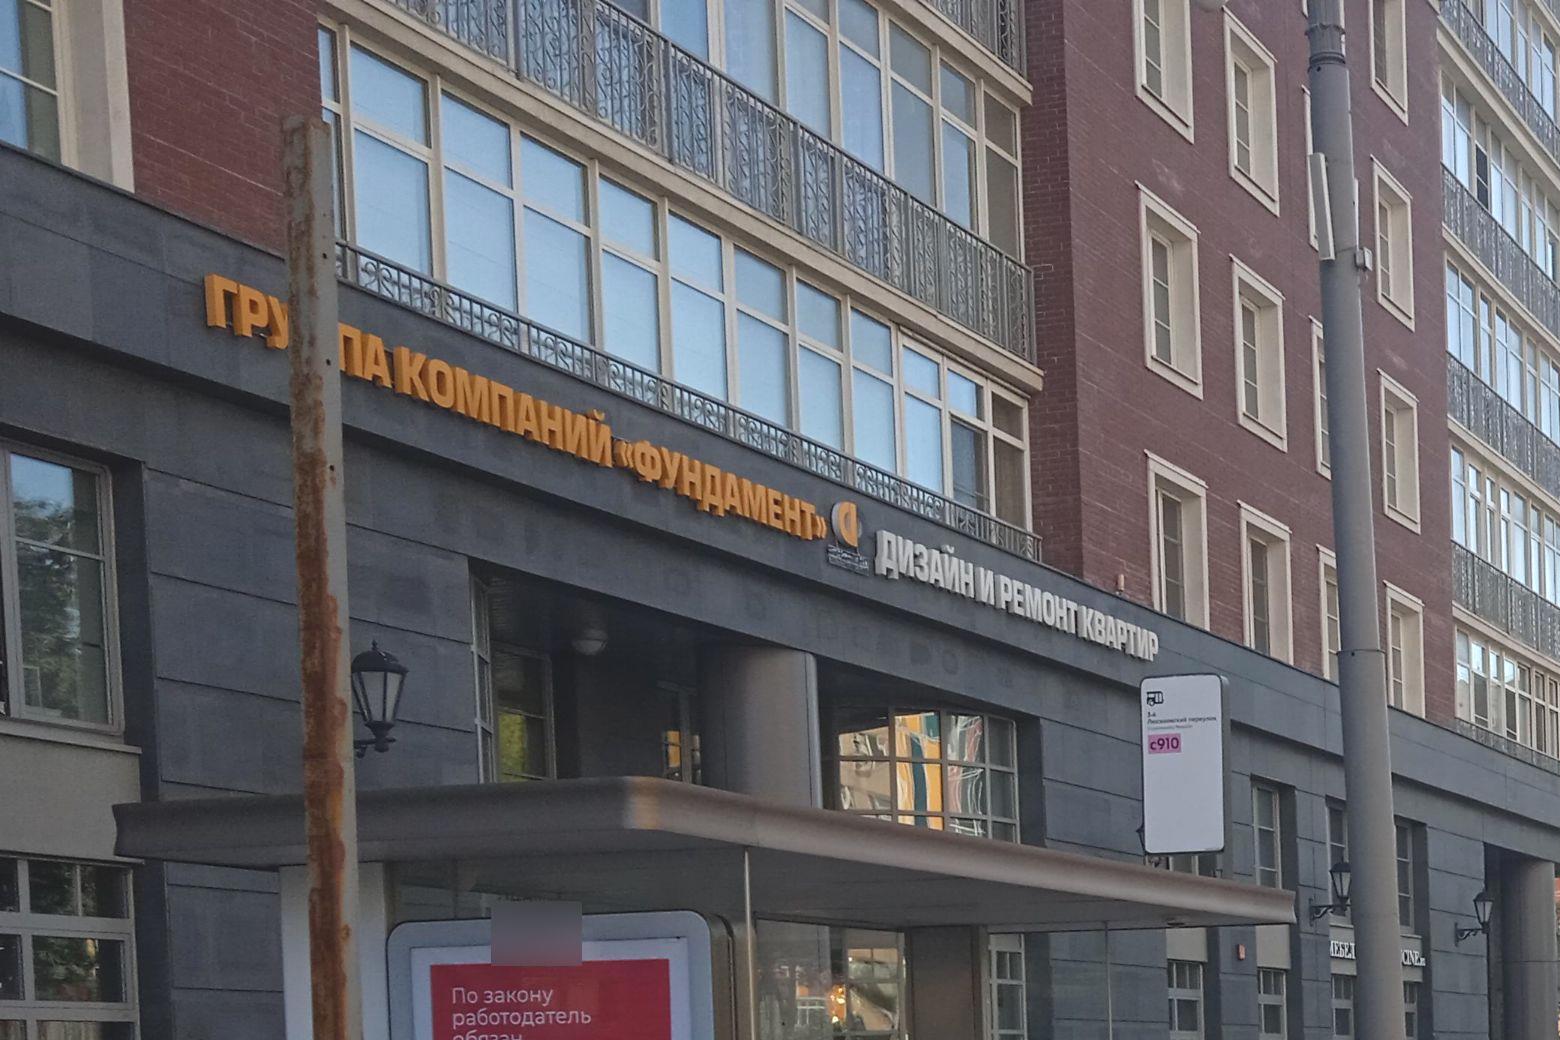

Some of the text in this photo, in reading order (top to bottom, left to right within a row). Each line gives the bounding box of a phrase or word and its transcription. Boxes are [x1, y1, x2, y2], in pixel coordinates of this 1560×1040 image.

[203, 273, 827, 541] ГРУПА КОМПАНИЙ «ФУНДАМЕНТ»
[875, 529, 975, 600] ДИЗАЙН
[978, 565, 996, 606] И
[994, 574, 1078, 634] РЕМОНТ
[1077, 604, 1160, 662] КВАРТИР
[452, 986, 554, 1008] По закону
[452, 1008, 593, 1030] работодатель
